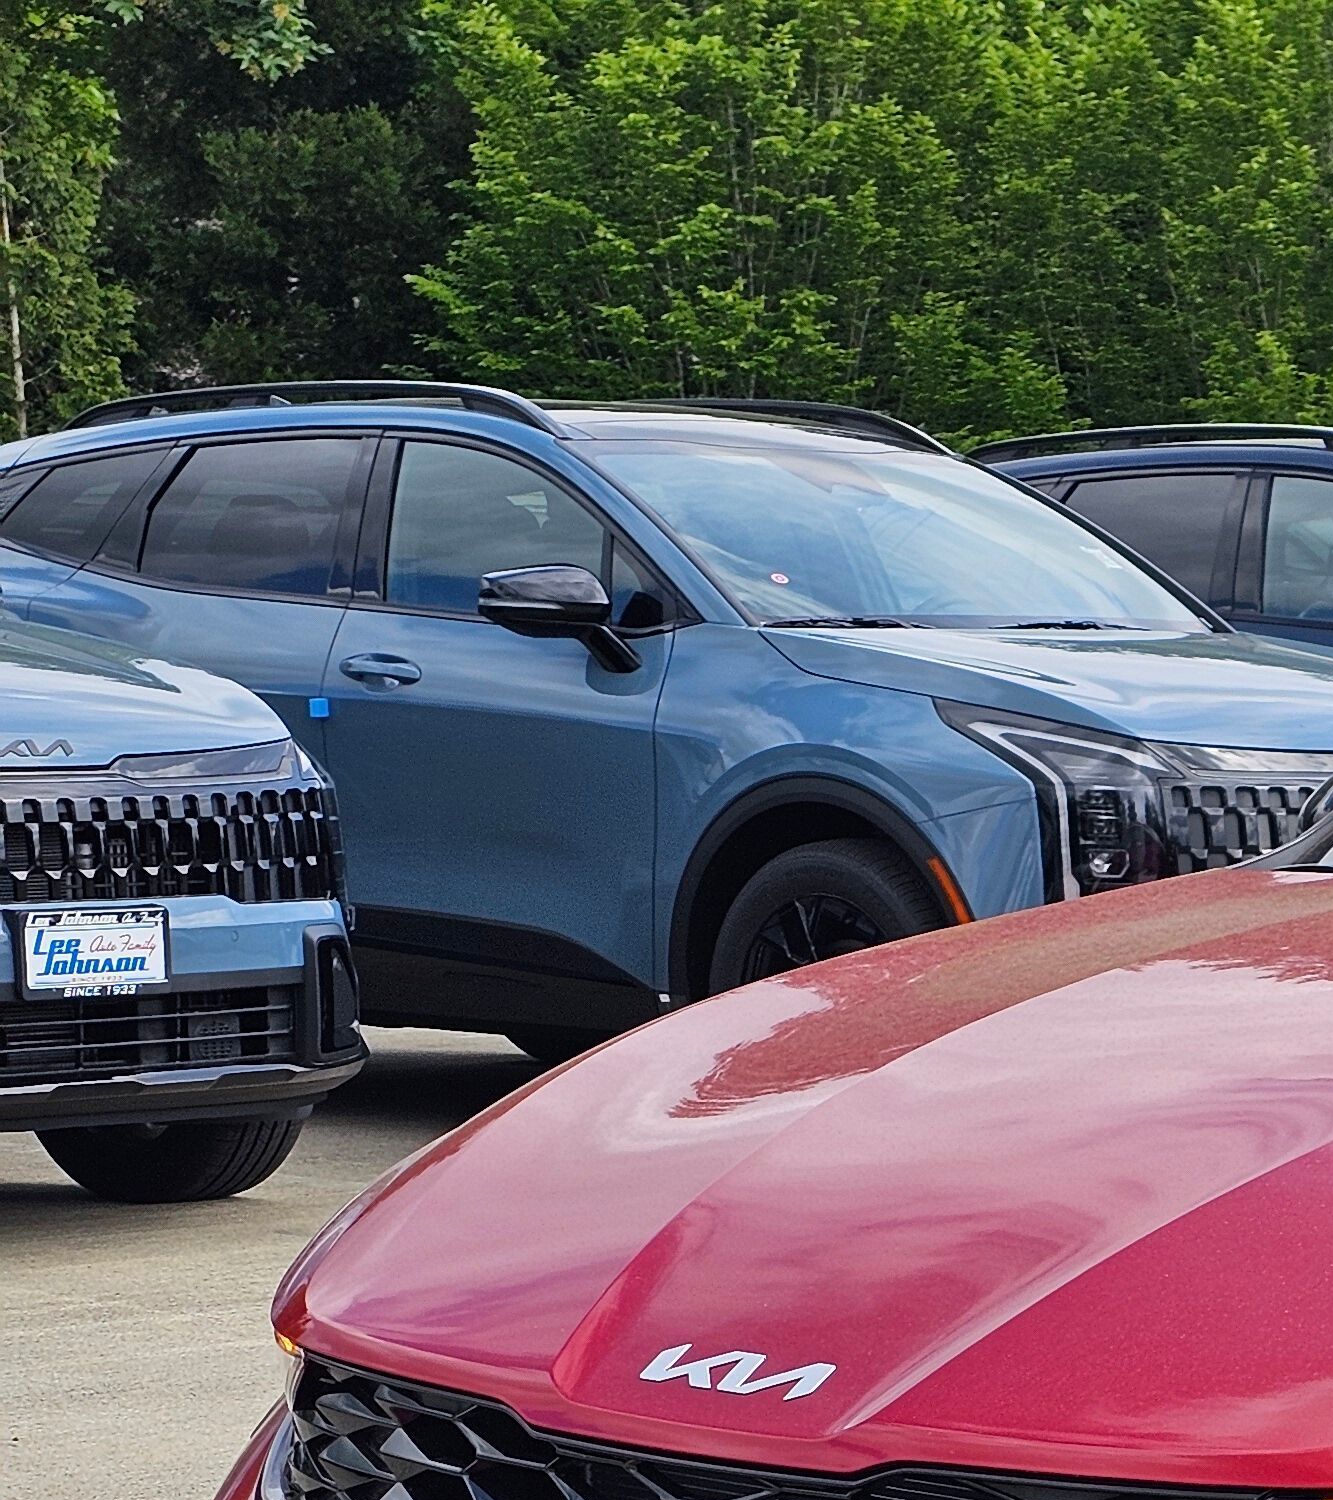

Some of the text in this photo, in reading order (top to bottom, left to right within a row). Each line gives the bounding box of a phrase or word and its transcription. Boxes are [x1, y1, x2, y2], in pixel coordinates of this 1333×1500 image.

[34, 929, 84, 955] Lee
[36, 952, 149, 976] Johnson
[63, 984, 137, 998] SINCE 1933
[639, 1343, 837, 1401] KIA
